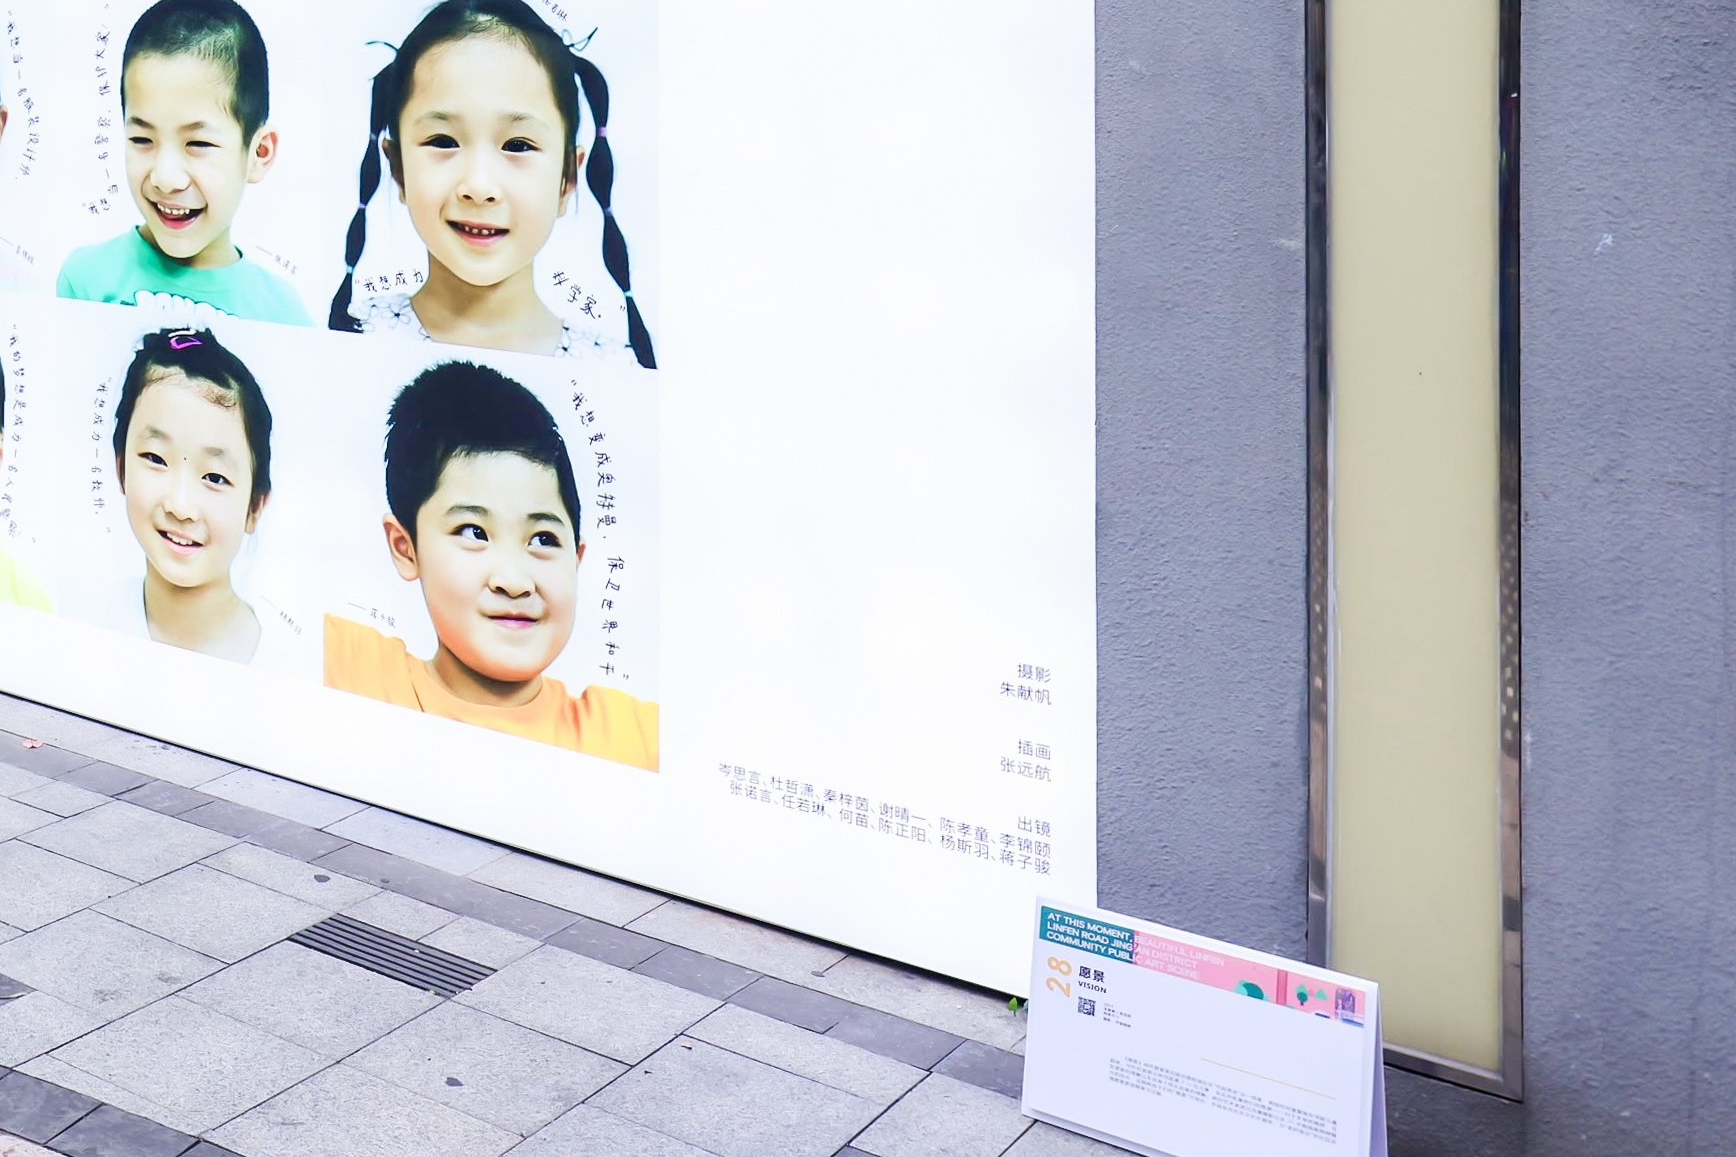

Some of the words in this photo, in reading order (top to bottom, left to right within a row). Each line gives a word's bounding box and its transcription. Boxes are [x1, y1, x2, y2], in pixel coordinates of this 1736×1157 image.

[1018, 663, 1051, 683] 摄影
[1000, 681, 1051, 706] 朱献帆
[1018, 738, 1051, 760] 插画
[1000, 756, 1051, 782] 张远航
[1018, 815, 1051, 838] 出镜
[1047, 913, 1062, 922] AT
[1063, 916, 1085, 929] THIS
[1046, 931, 1106, 955] COMMUNITY
[1107, 946, 1143, 964] PUBLIC
[1143, 957, 1166, 971] ART
[1047, 922, 1080, 937] LINFEN
[1081, 931, 1109, 945] ROAD
[1153, 950, 1198, 968] DISTRICT
[1046, 956, 1072, 998] 28
[1078, 965, 1105, 983] 愿景
[1078, 980, 1107, 994] VISION
